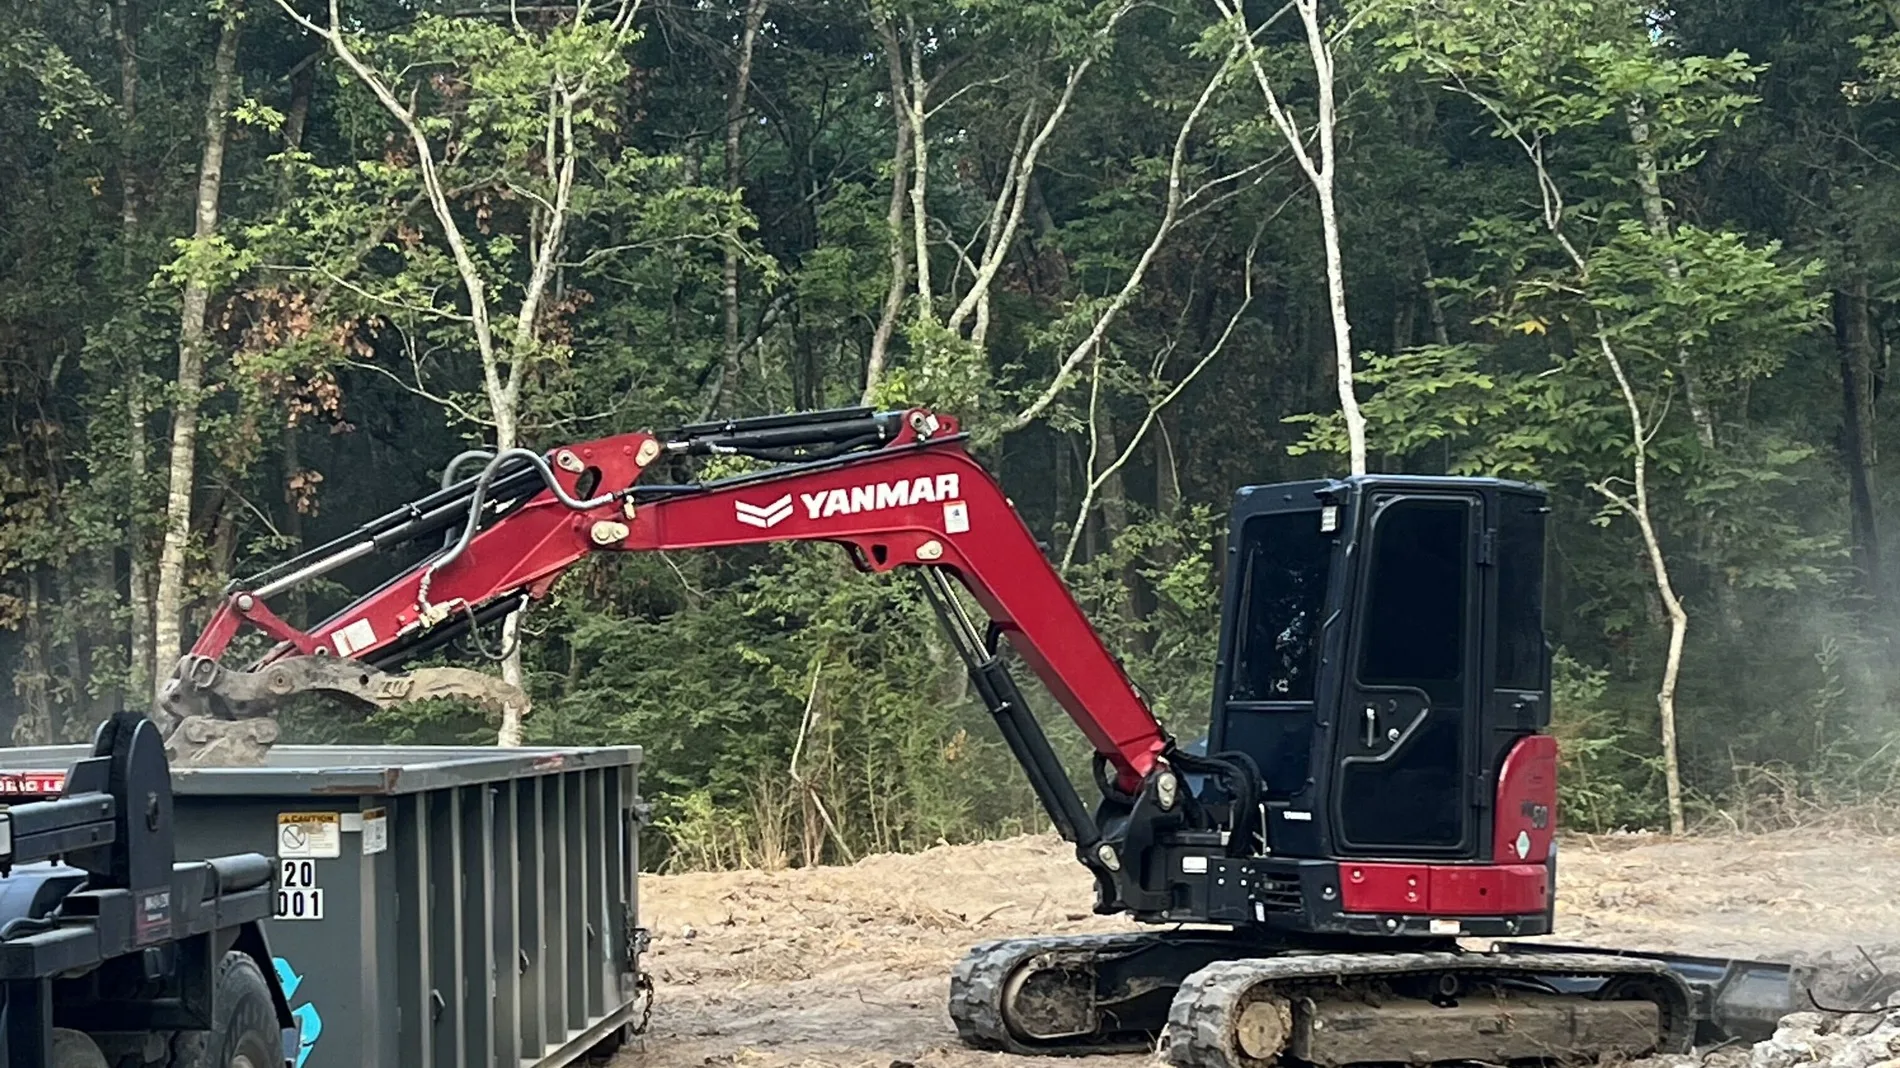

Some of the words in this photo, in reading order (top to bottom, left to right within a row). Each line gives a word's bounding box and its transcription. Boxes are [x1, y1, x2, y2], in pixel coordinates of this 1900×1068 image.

[801, 474, 959, 519] YANMAR
[291, 815, 334, 823] CAUTION
[285, 861, 311, 887] 20
